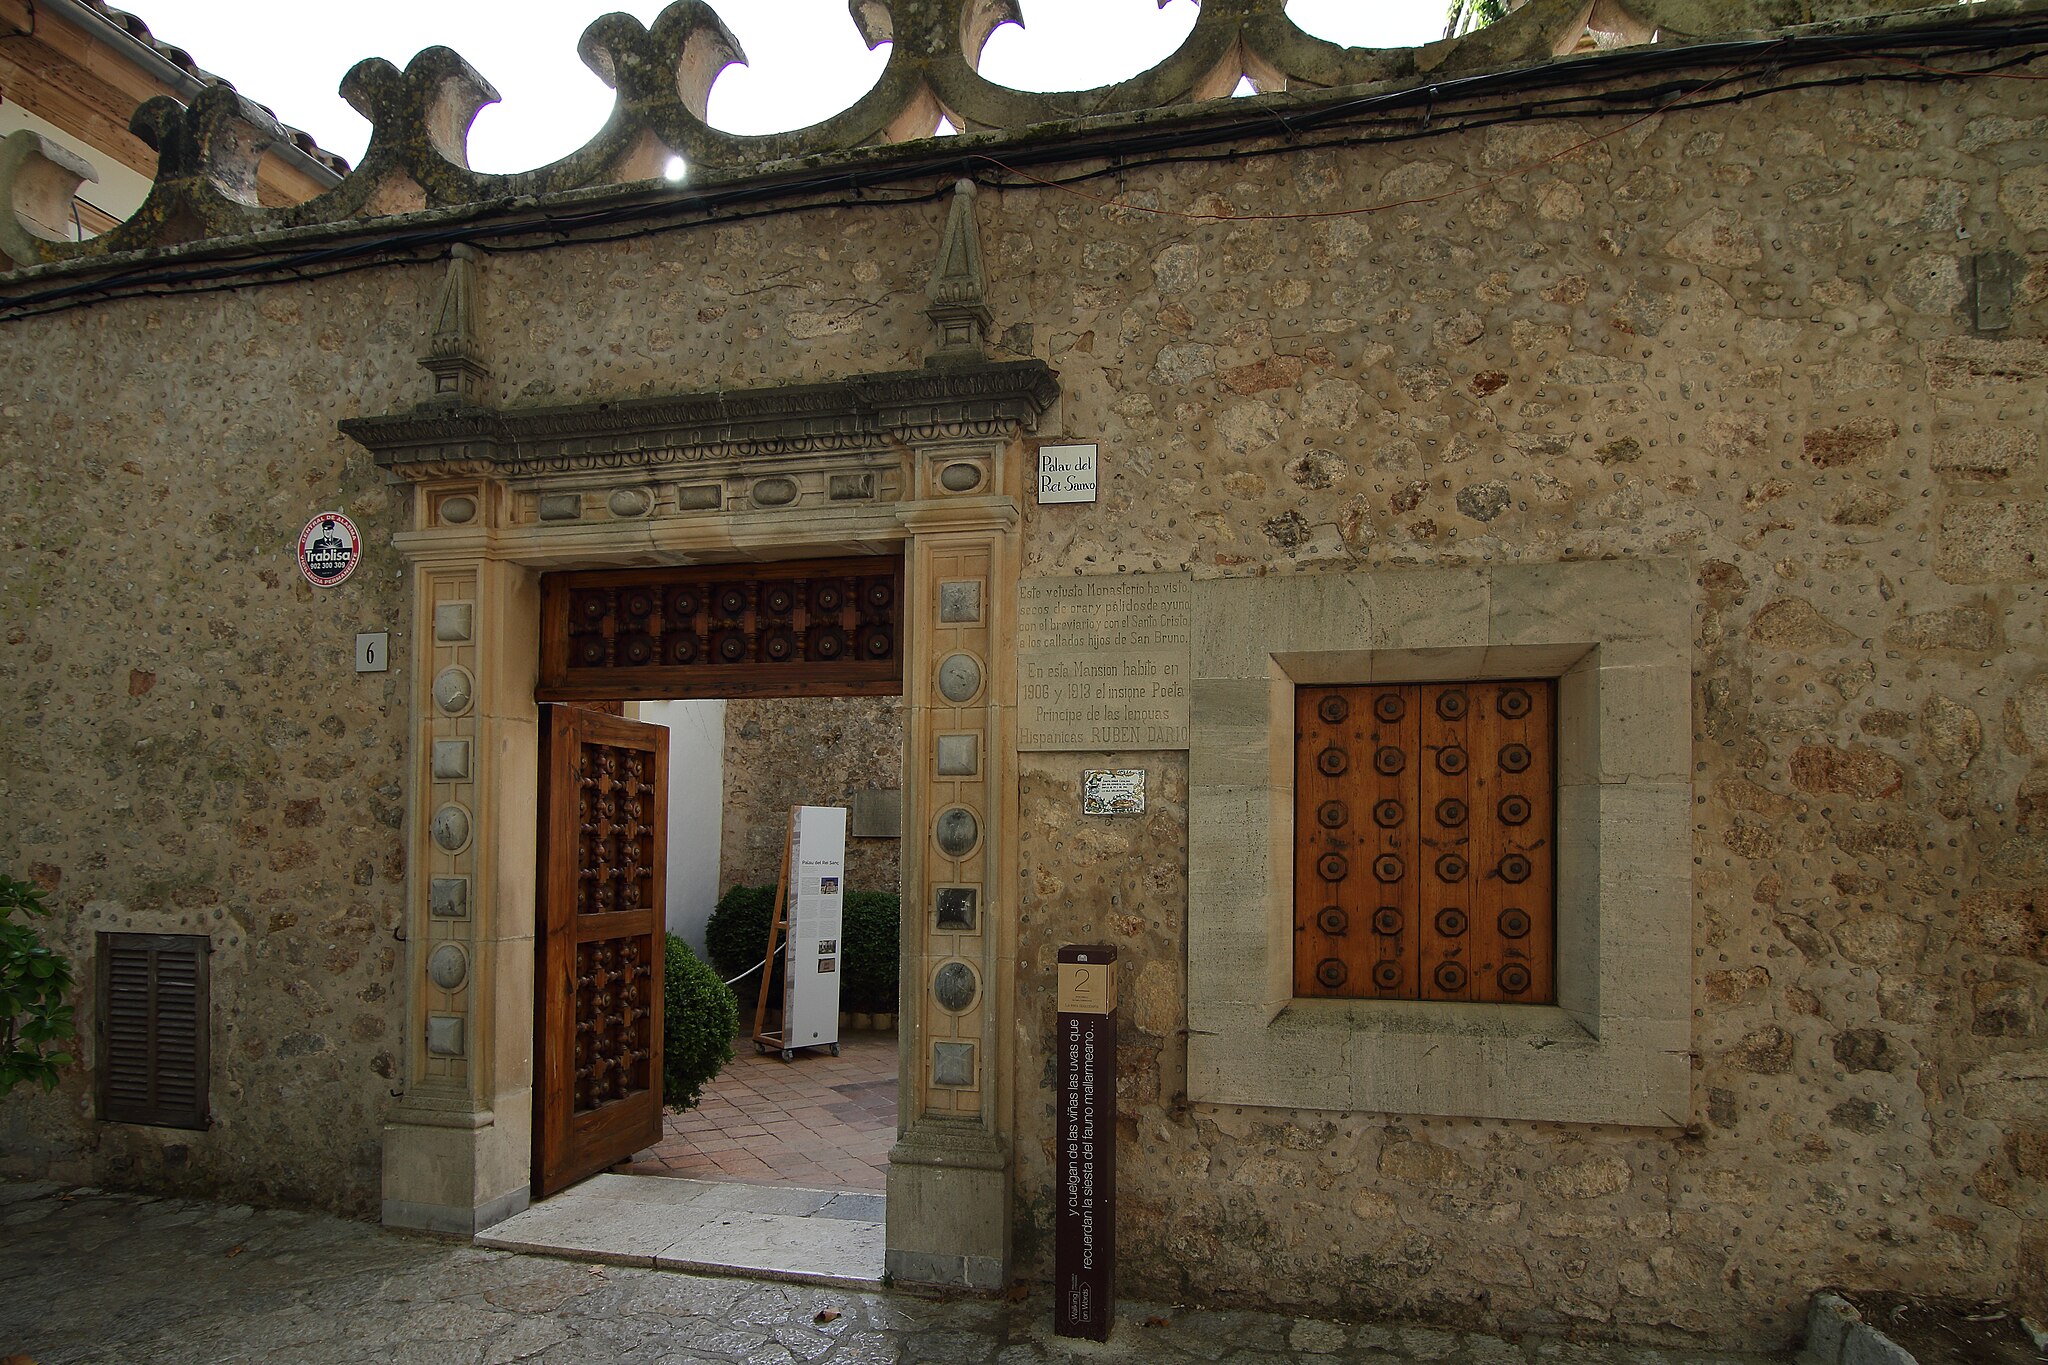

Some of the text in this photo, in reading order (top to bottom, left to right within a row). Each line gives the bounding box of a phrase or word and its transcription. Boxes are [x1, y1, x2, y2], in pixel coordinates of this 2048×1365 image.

[1042, 455, 1092, 472] Palau del
[1041, 475, 1062, 492] Rei
[301, 516, 325, 543] CENTRAL
[336, 516, 357, 540] ALARMA
[305, 549, 351, 562] Trablisa
[334, 561, 346, 569] 309
[324, 552, 358, 585] PERMANENTE
[1020, 586, 1041, 599] Este
[1046, 584, 1083, 598] vetusto
[1087, 582, 1145, 596] Monasterio
[1148, 581, 1160, 594] ha
[1020, 606, 1049, 615] secos
[1054, 601, 1067, 614] de
[1147, 597, 1158, 610] de
[1161, 601, 1190, 613] ayuno
[1019, 623, 1037, 632] con
[1039, 618, 1047, 631] el
[1050, 618, 1094, 631] breviario
[1104, 620, 1119, 629] con
[1122, 615, 1129, 628] el
[1131, 614, 1157, 628] Santo
[1160, 613, 1188, 627] Cristo
[1019, 631, 1188, 650] a los callados hijos de San Bruno.
[366, 641, 375, 665] 6
[1027, 662, 1043, 678] En
[1048, 662, 1069, 678] esta
[1164, 664, 1179, 675] en
[1024, 681, 1185, 705] 1906 y 1913 el insigne Poeta
[1086, 705, 1100, 721] de
[1104, 705, 1120, 721] las
[1124, 704, 1169, 724] lenguas
[1090, 726, 1141, 743] RUBEN
[1075, 968, 1090, 992] 2
[1067, 1019, 1081, 1217] y cuelgan de las viñas las uvas que
[1082, 1021, 1094, 1270] recuerdan la siesta del fauno mallarmeano...
